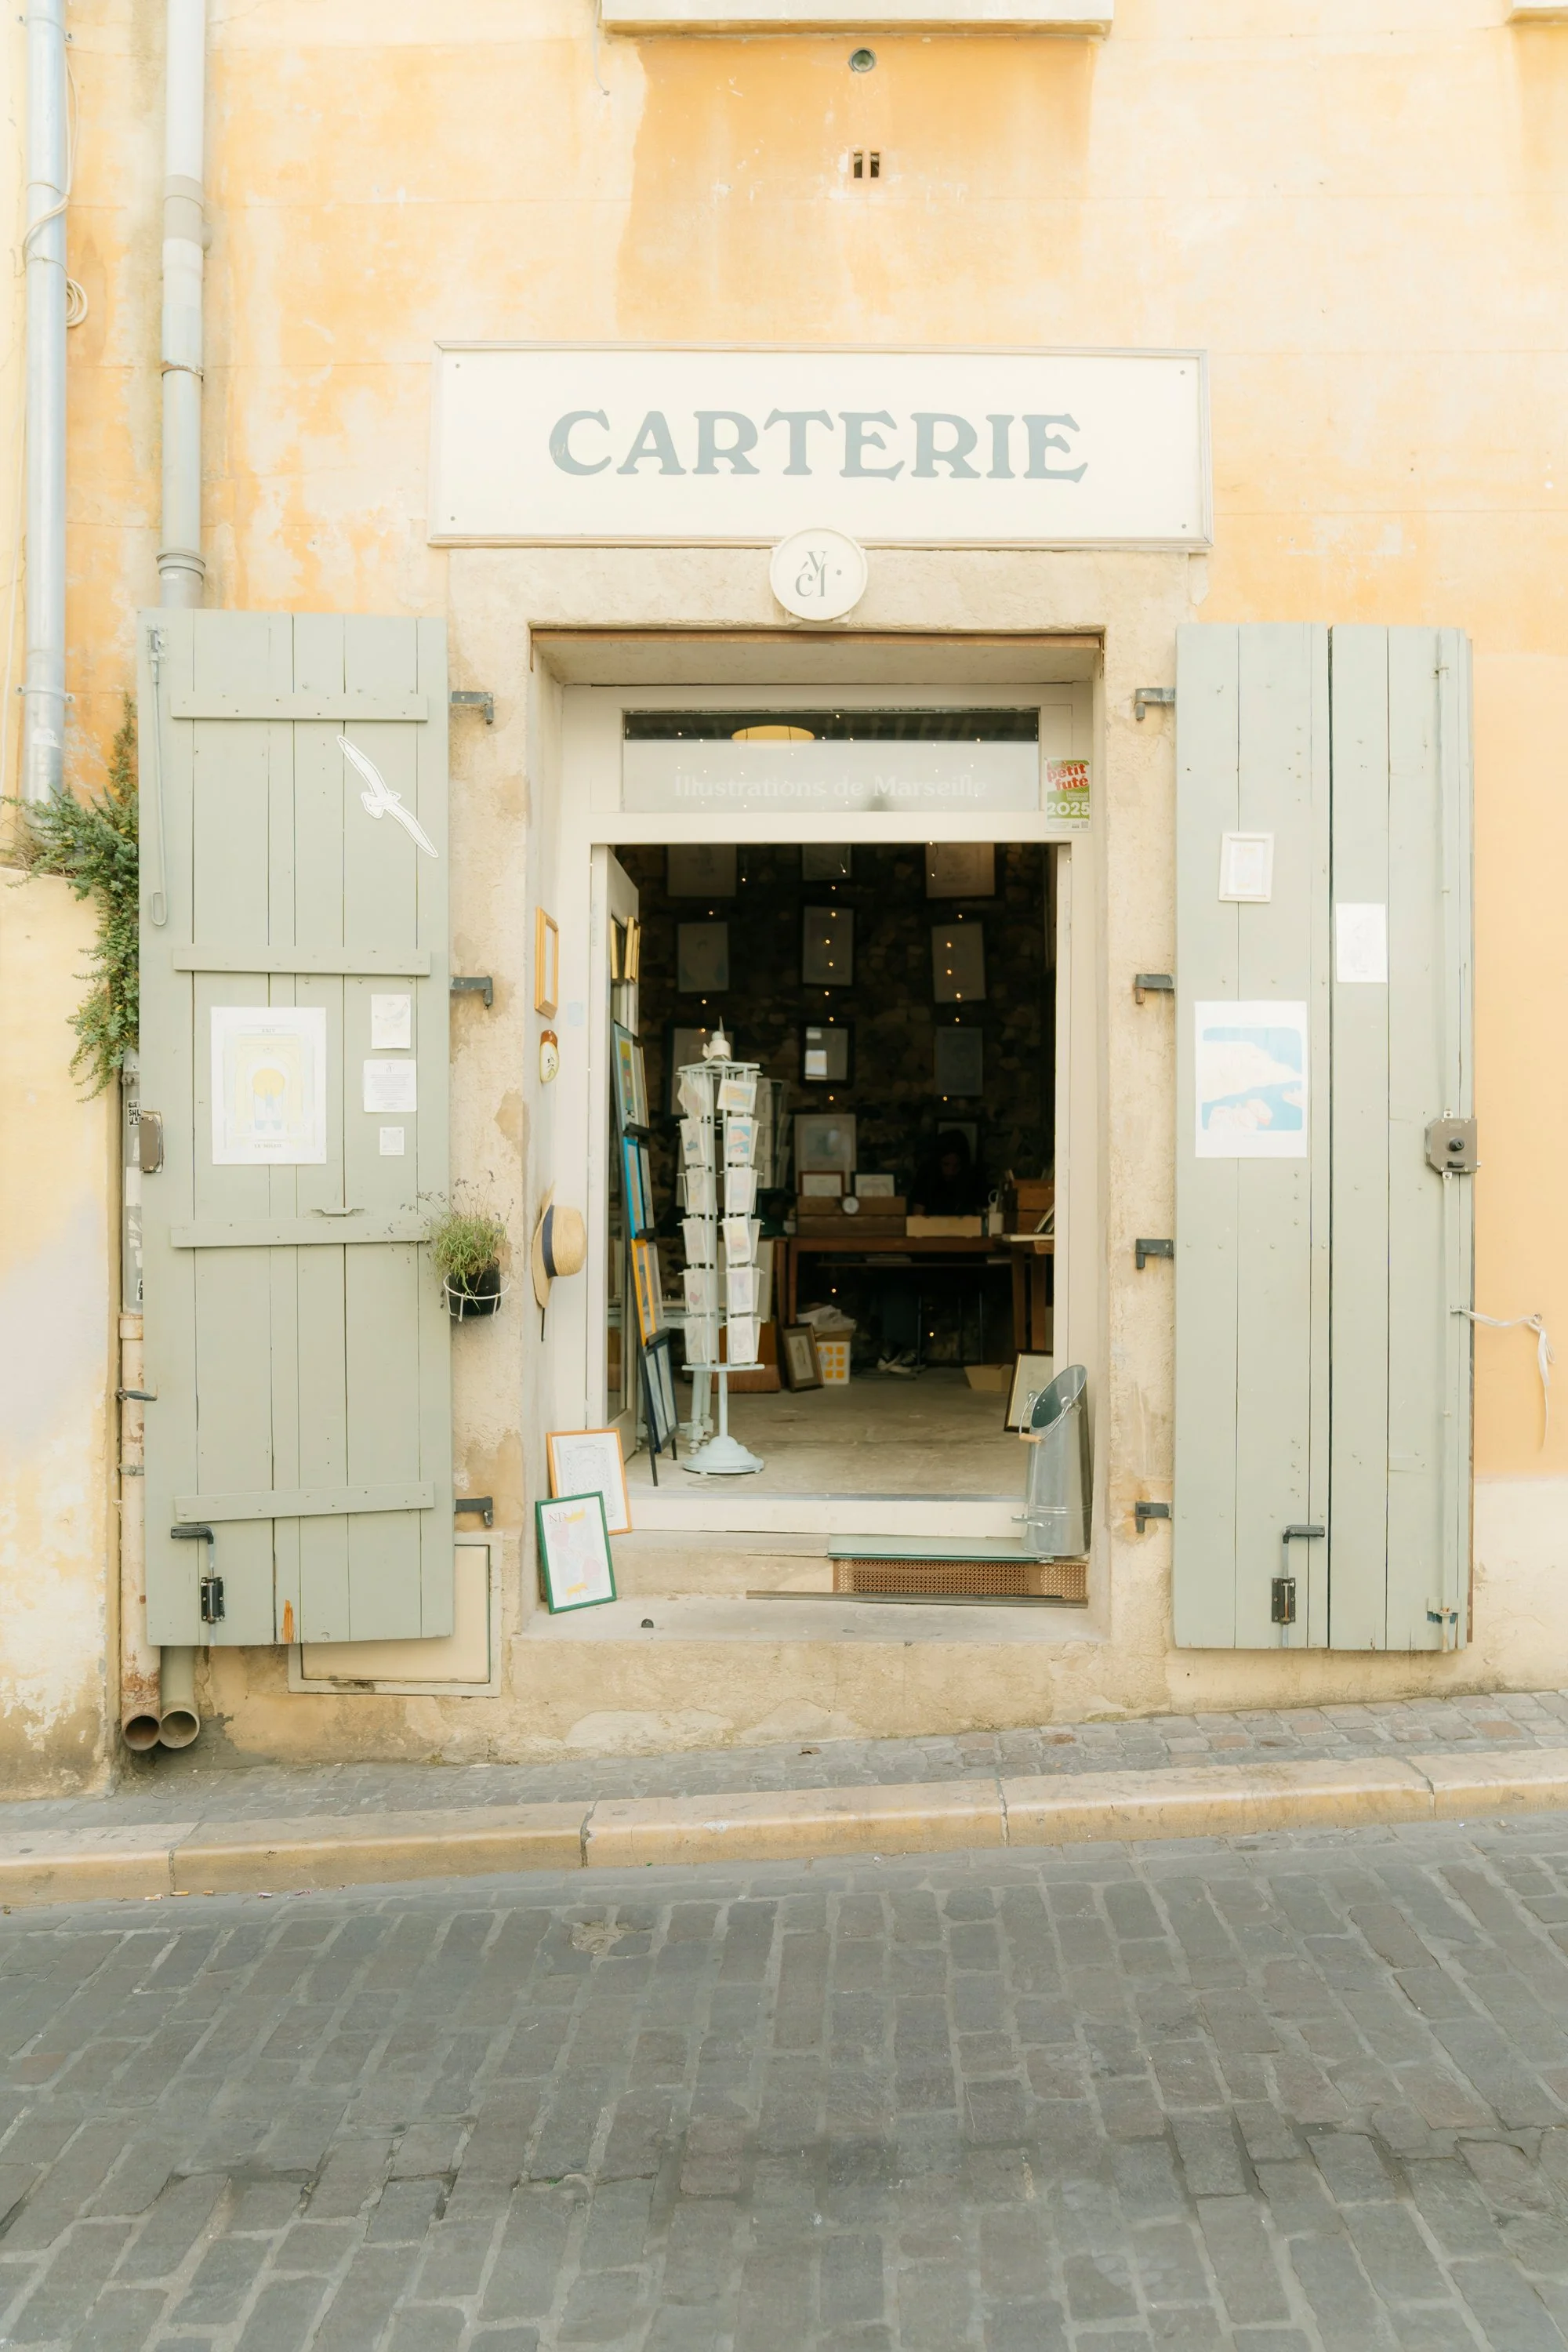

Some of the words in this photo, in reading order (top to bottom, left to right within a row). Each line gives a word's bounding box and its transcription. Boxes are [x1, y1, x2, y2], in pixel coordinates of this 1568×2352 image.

[550, 408, 1088, 484] CARTERIE
[673, 775, 827, 797] Illustrations
[833, 775, 865, 797] de
[873, 774, 987, 797] Marseille
[1047, 801, 1090, 816] 2025
